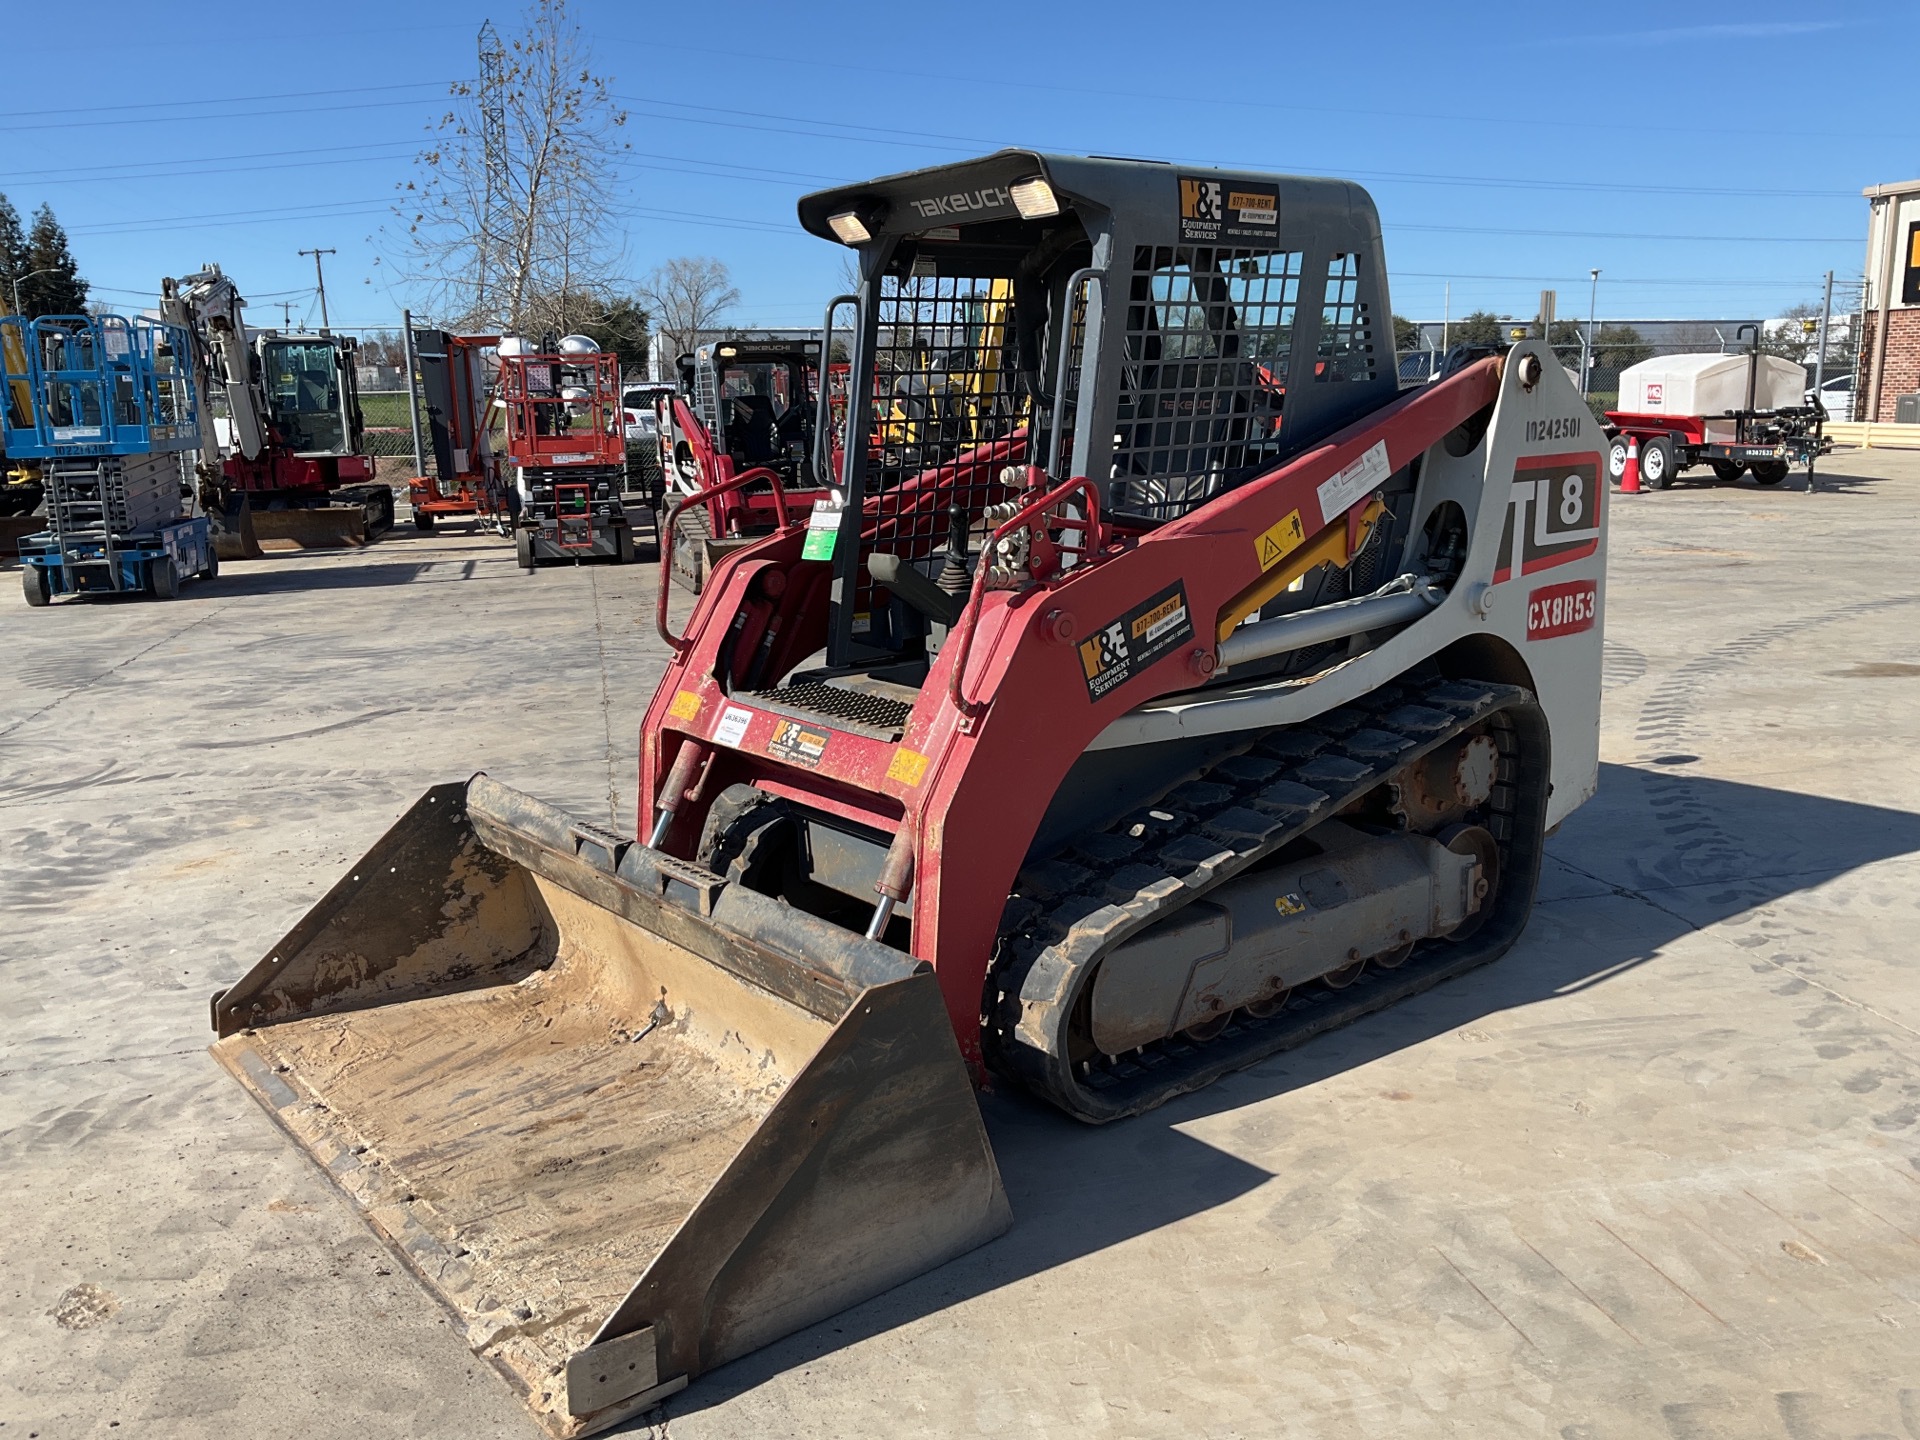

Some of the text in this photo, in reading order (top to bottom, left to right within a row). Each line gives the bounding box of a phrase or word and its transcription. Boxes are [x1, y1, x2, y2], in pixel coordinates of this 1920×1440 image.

[910, 186, 1013, 217] TAKEUCH
[1181, 180, 1222, 220] H&E
[1232, 196, 1272, 209] 877-700-RENT
[1182, 219, 1221, 231] EQUIPMENT
[1185, 228, 1217, 240] SERVICES
[1526, 418, 1581, 442] 10242501
[1508, 474, 1600, 579] TL8
[1136, 600, 1177, 633] 877-700-RENT
[1528, 590, 1596, 631] CX8R53
[1080, 622, 1129, 680] H&E
[1089, 658, 1130, 690] EQUIPMENT
[1094, 669, 1129, 696] SERVICES
